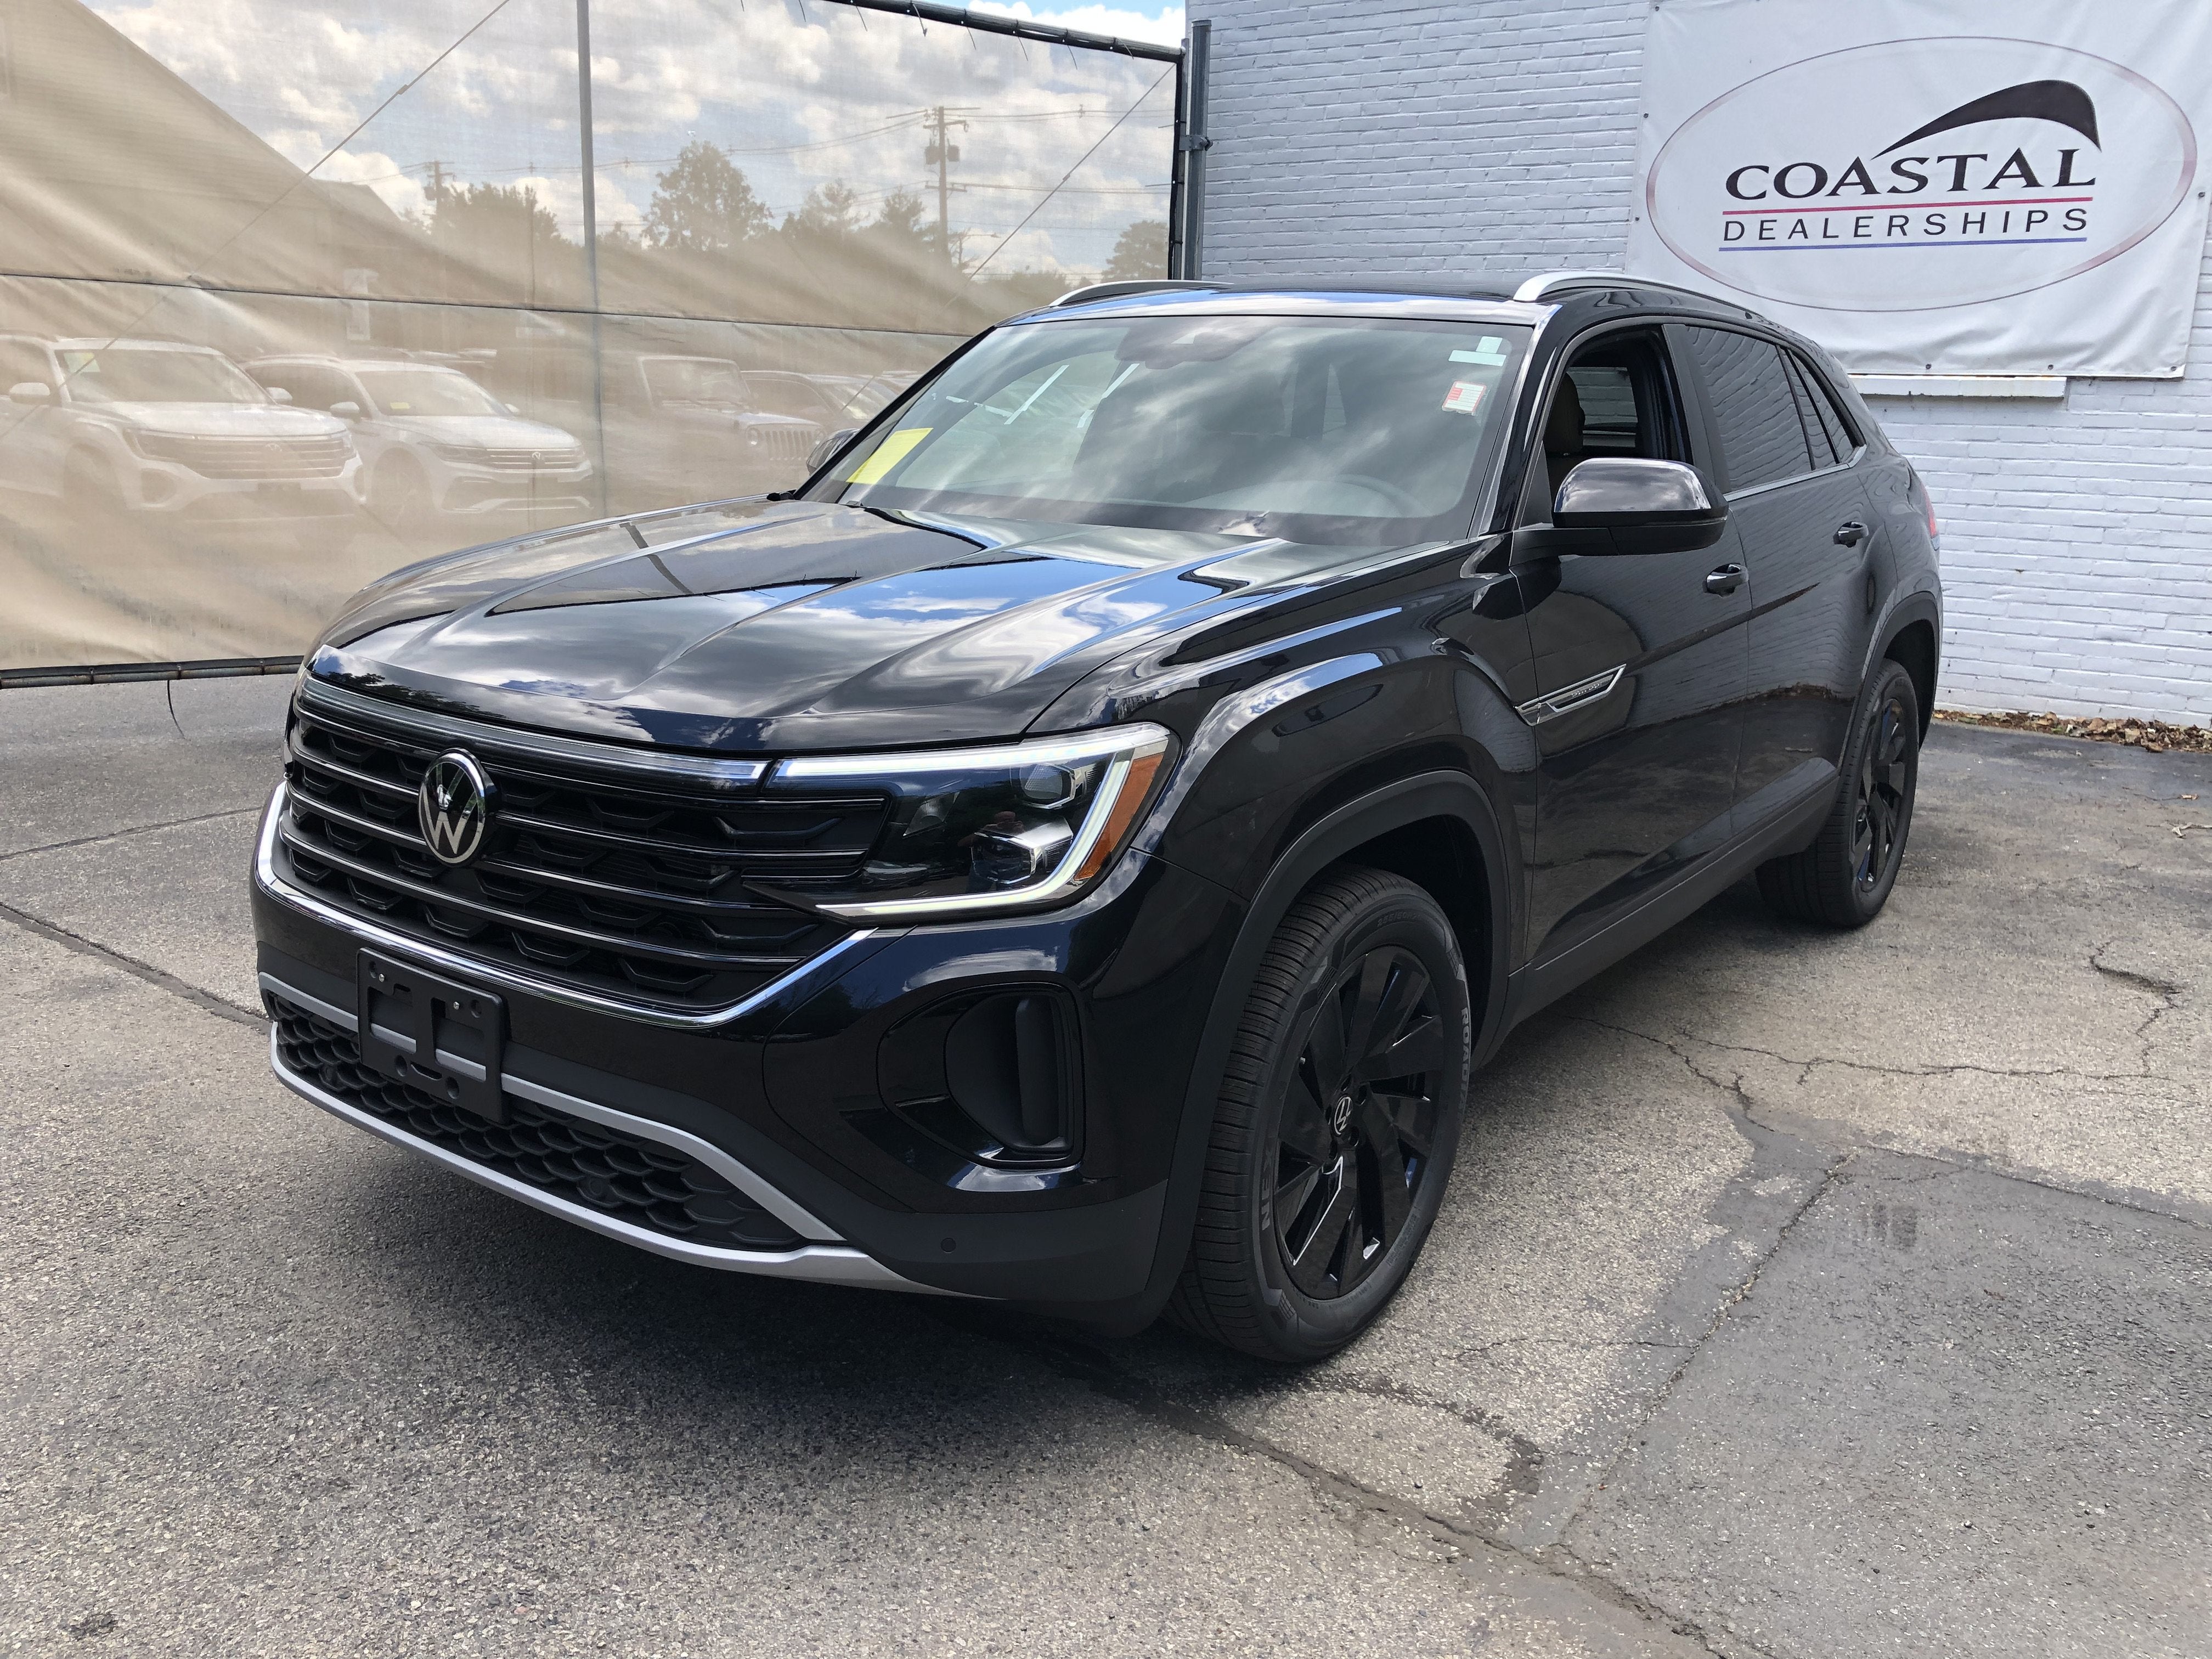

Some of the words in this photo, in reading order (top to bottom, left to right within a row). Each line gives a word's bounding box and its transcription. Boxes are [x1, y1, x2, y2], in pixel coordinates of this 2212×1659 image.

[1725, 148, 2096, 200] COASTAL
[1723, 208, 2087, 241] DEALERSHIPS
[1457, 1007, 1470, 1114] ROADIA
[1261, 1148, 1273, 1231] NEX
